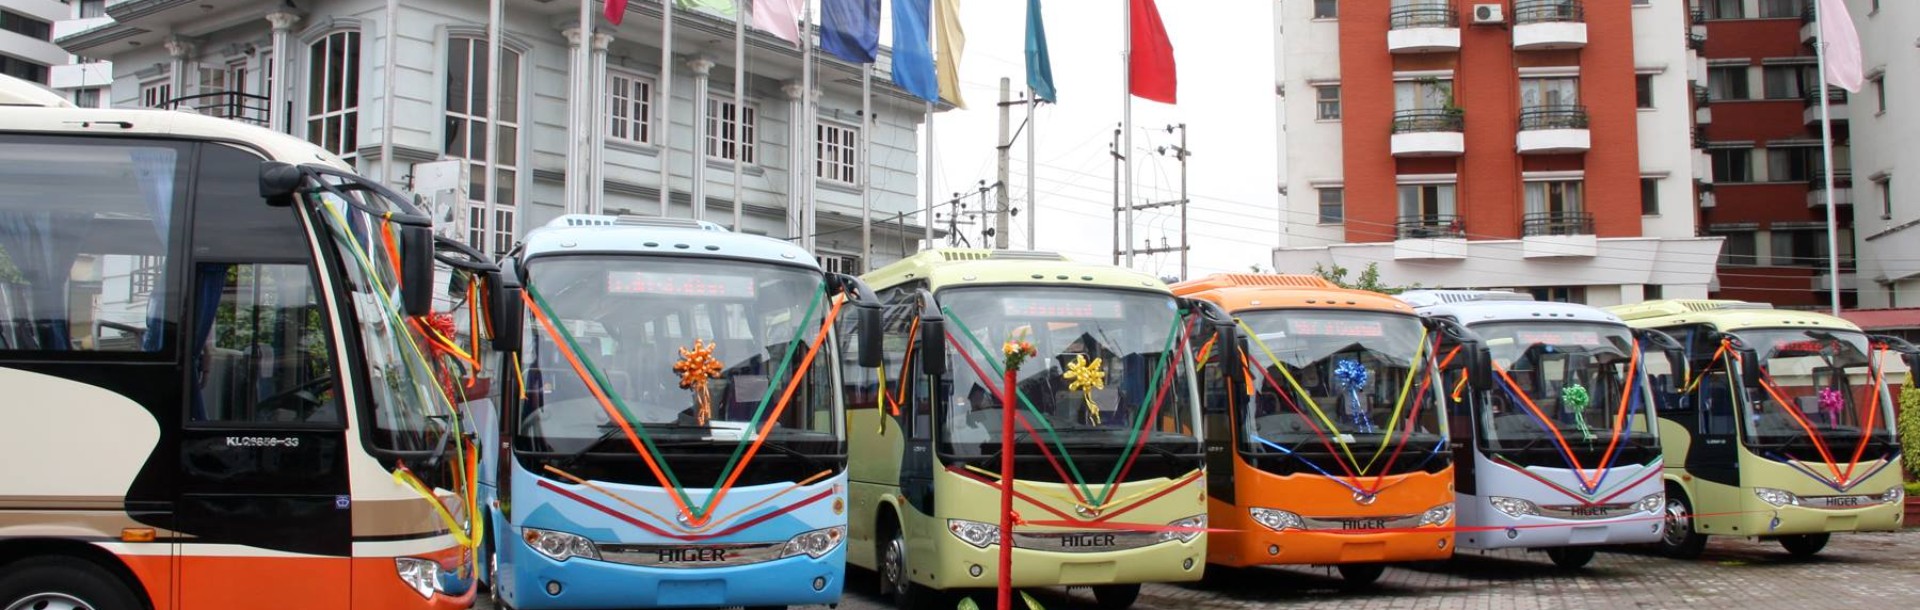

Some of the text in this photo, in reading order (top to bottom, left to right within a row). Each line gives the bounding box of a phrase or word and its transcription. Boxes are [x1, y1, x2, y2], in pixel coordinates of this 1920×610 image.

[1826, 497, 1858, 506] HIGER
[1571, 506, 1607, 516] HIGER
[1343, 519, 1385, 530] HIGER
[1062, 534, 1115, 547] HIGER
[659, 548, 725, 562] HIGER
